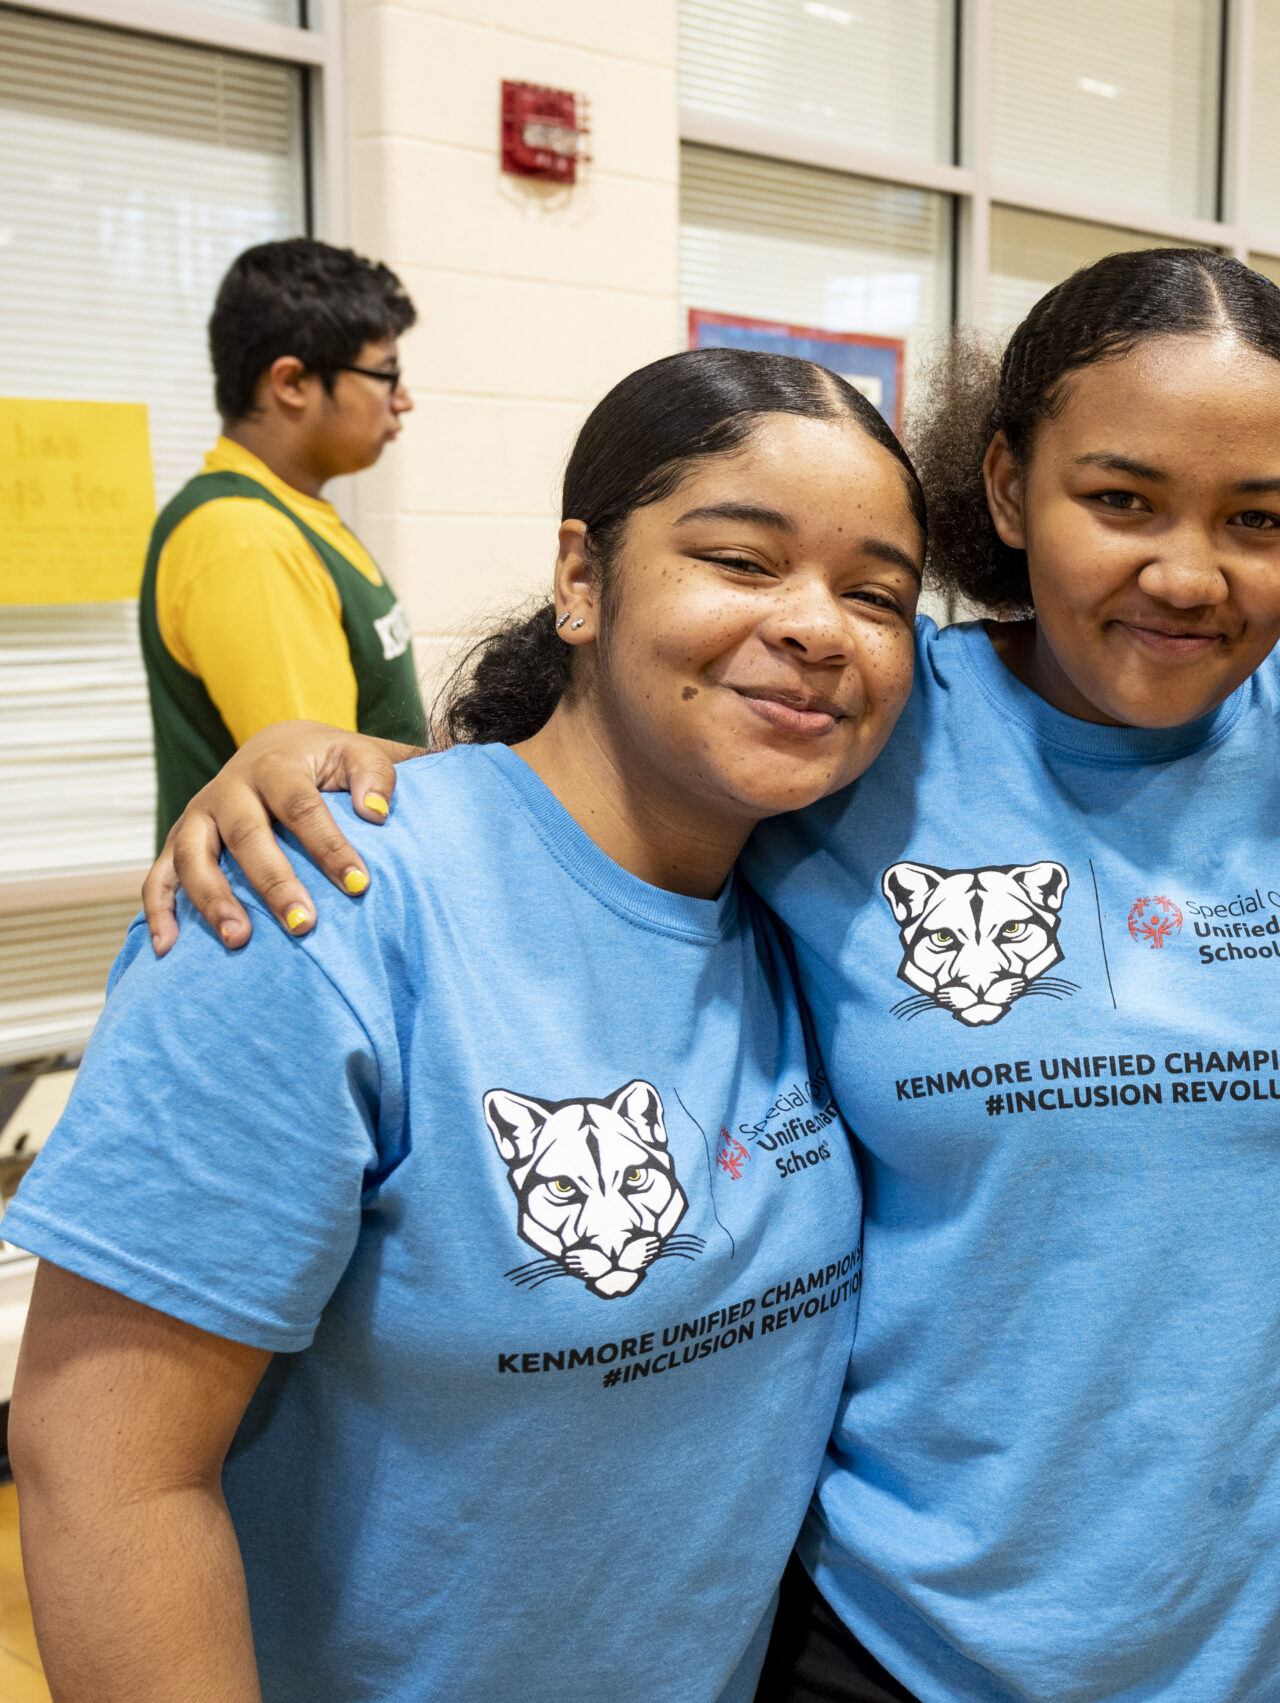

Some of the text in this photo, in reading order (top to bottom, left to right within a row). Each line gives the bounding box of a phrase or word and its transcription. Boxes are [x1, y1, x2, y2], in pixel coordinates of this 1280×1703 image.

[1185, 888, 1266, 919] Special
[1193, 914, 1280, 938] Unified
[895, 1060, 1033, 1101] KENMORE
[1039, 1053, 1156, 1081] UNIFIED
[985, 1082, 1163, 1116] #INCLUSION
[739, 1084, 809, 1141] Special
[498, 1332, 655, 1373] KENMORE
[662, 1298, 756, 1346] UNIFIED
[602, 1320, 755, 1388] #INCLUSION
